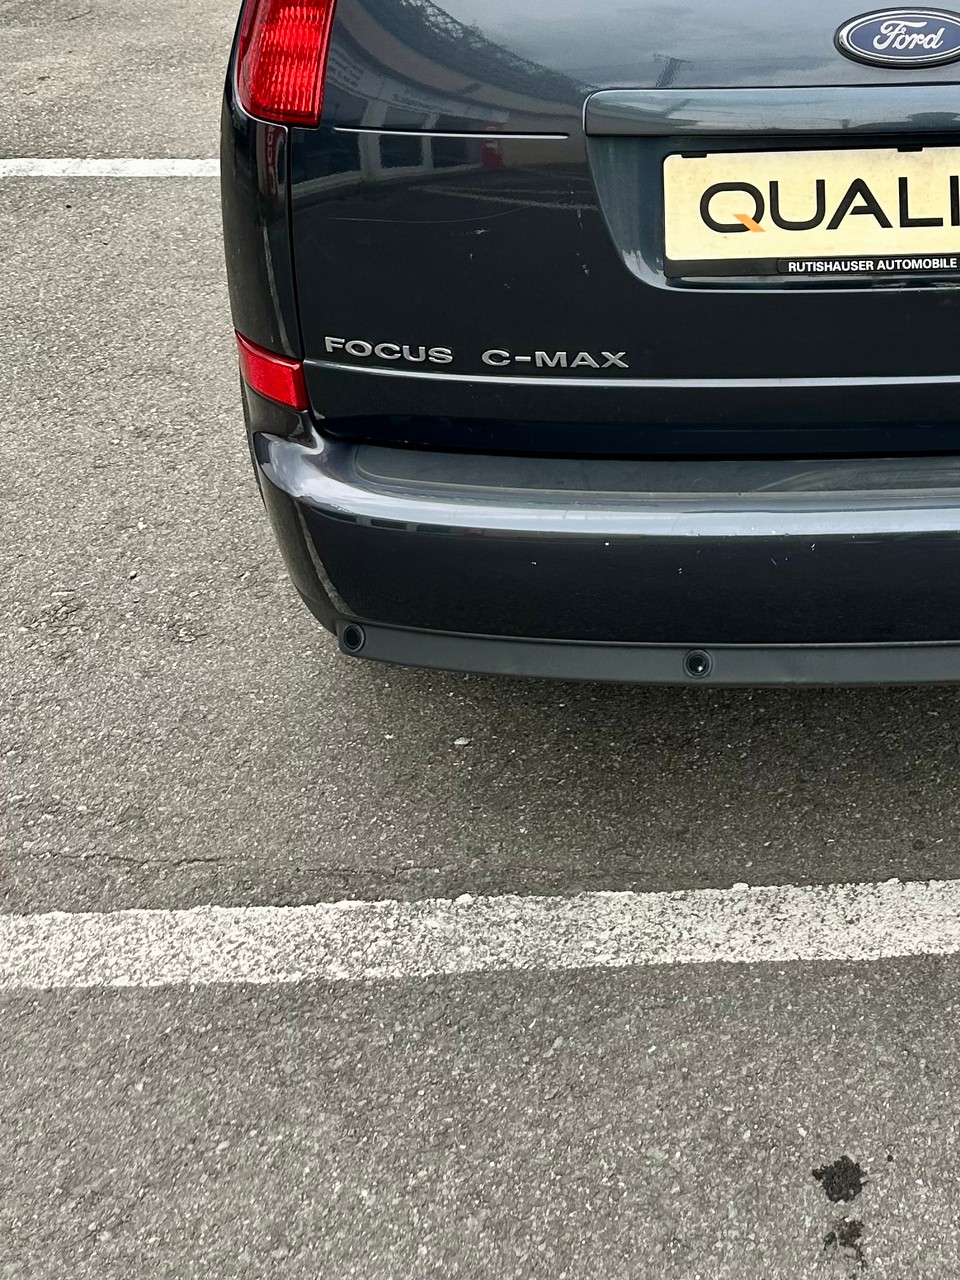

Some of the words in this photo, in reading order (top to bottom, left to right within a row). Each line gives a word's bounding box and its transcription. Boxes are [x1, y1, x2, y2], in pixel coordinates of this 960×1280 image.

[872, 20, 945, 50] Ford
[788, 260, 874, 272] RUTISHAUSER
[876, 257, 958, 270] AUTOMOBILE
[324, 336, 454, 364] FOCUS
[481, 349, 630, 369] C-MAX
